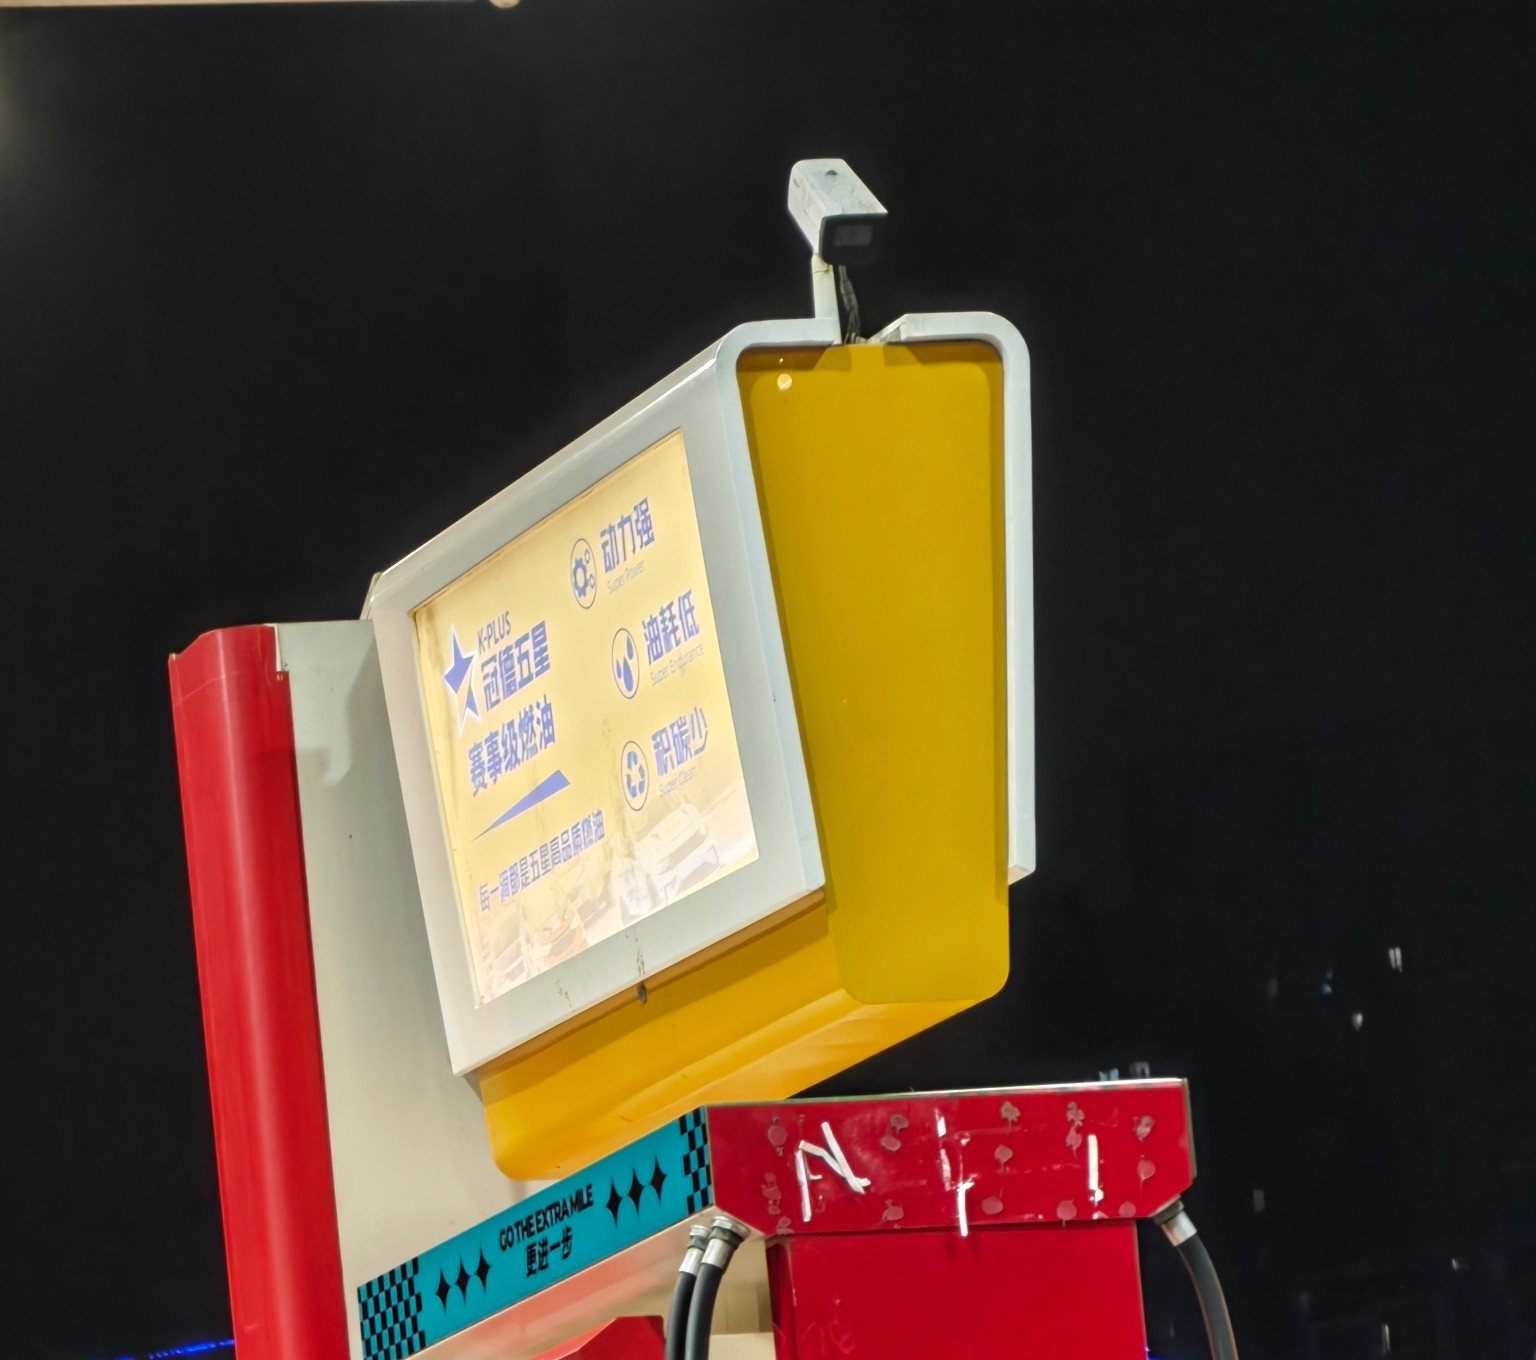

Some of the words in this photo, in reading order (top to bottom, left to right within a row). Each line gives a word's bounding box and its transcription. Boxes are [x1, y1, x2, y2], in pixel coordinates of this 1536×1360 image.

[600, 497, 656, 574] 动力强
[477, 610, 512, 655] K-PLUS
[480, 620, 551, 712] 冠德五星
[642, 589, 700, 666] 油耗低
[467, 695, 556, 798] 赛事级燃油
[651, 706, 709, 777] 积碳少
[499, 1225, 515, 1251] GO
[513, 1214, 536, 1243] THE
[535, 1197, 571, 1233] EXTRA
[569, 1183, 594, 1216] MILE
